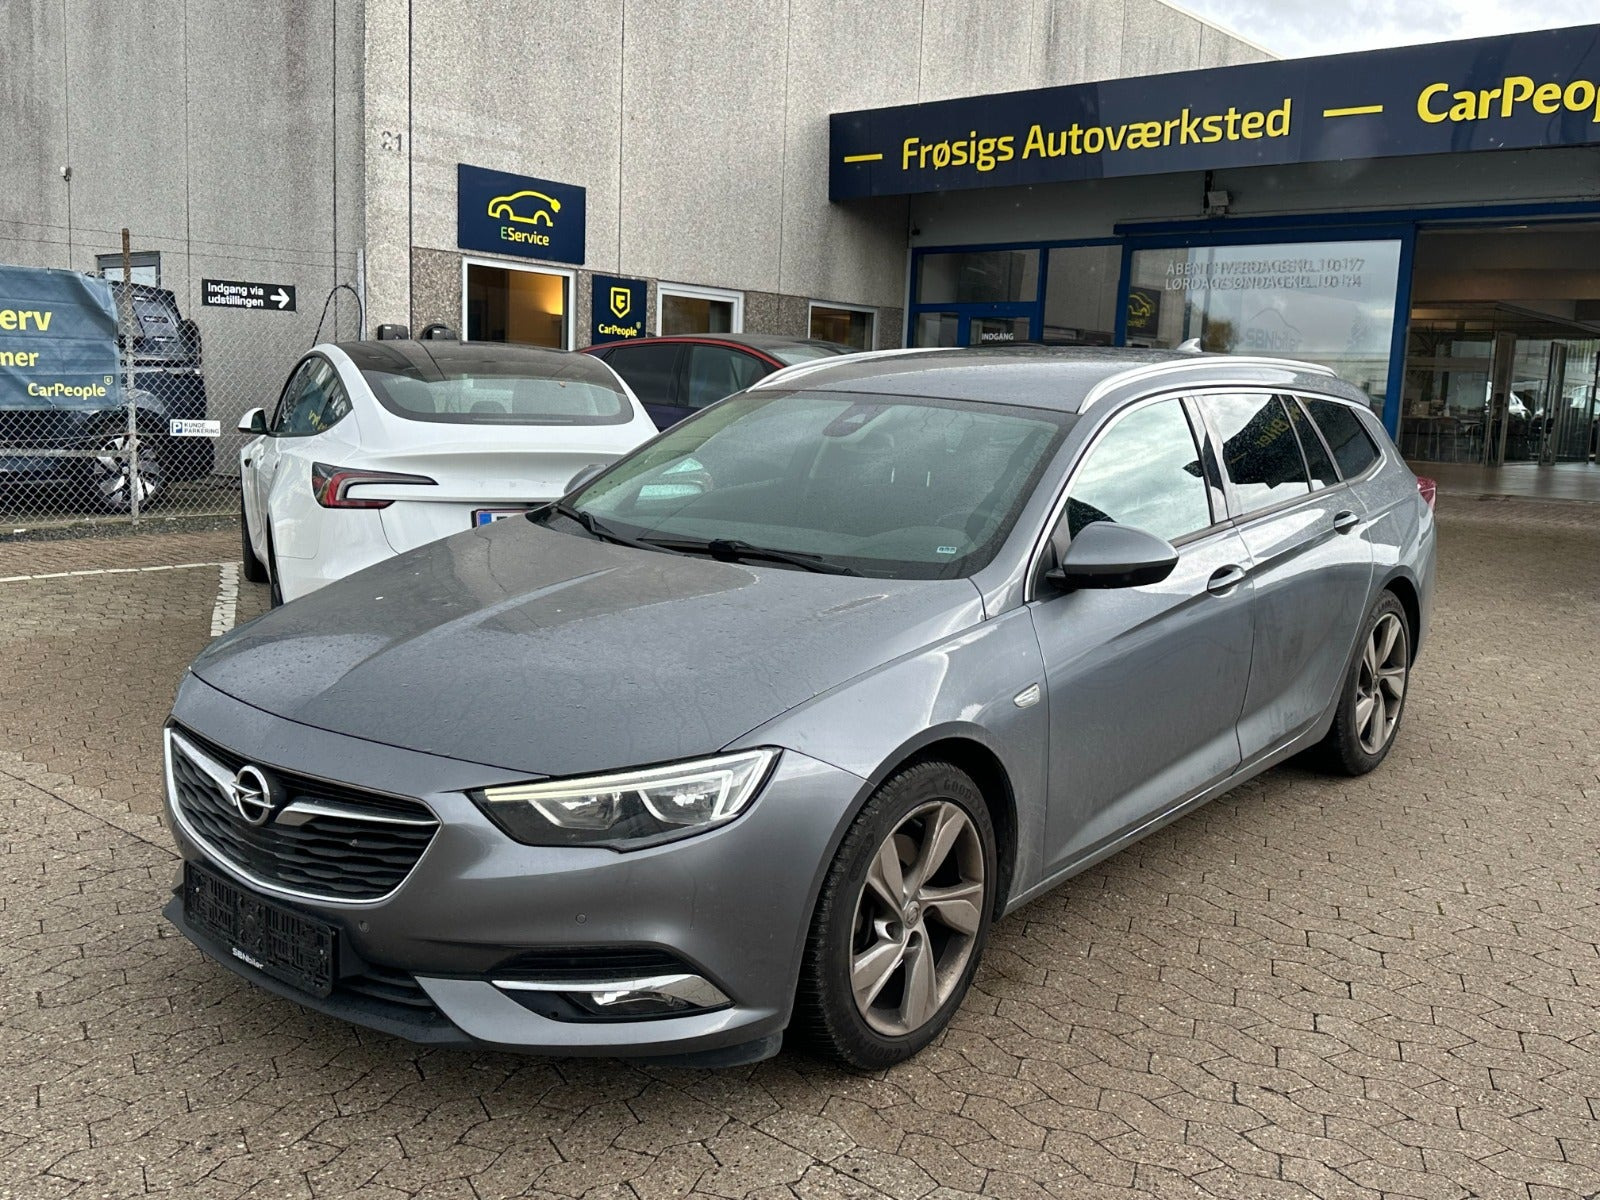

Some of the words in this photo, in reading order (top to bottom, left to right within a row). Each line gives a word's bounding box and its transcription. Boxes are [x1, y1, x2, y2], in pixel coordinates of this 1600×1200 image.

[902, 130, 1014, 171] Frøsigs
[1022, 98, 1292, 160] Autoværksted
[207, 282, 248, 297] Indgang
[249, 286, 264, 296] via
[207, 294, 264, 308] udstillingen
[598, 323, 638, 339] CarPeople
[981, 332, 1014, 341] INDGANG
[27, 382, 107, 401] CarPeople
